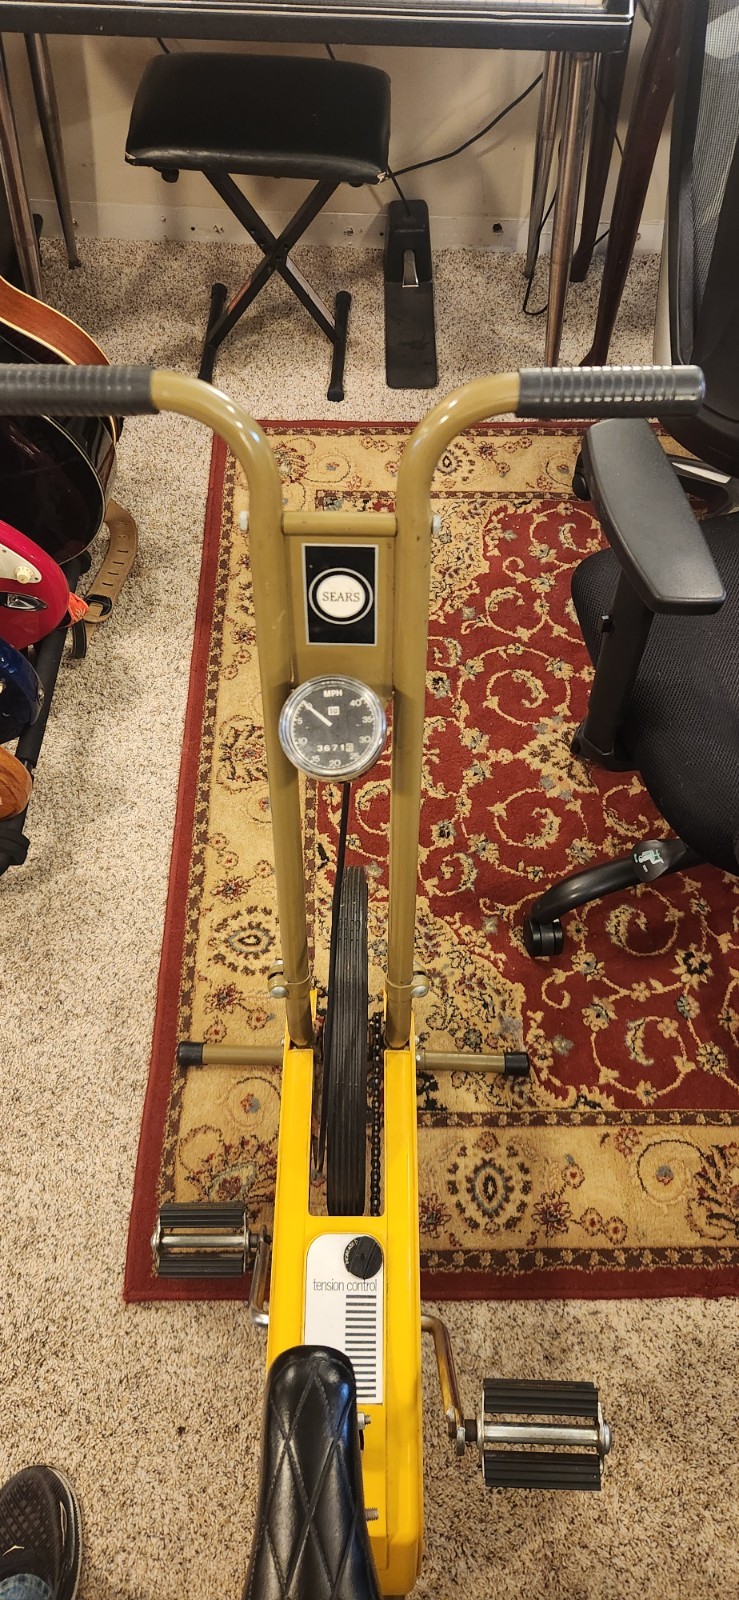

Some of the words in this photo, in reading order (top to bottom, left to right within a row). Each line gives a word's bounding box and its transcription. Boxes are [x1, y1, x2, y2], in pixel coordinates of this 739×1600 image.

[322, 591, 360, 602] SEARS
[323, 689, 343, 698] MPH
[297, 717, 303, 725] 5
[298, 737, 308, 745] 10
[359, 735, 371, 743] 30
[349, 752, 360, 760] 25
[313, 1278, 345, 1291] tension
[346, 1278, 377, 1292] control
